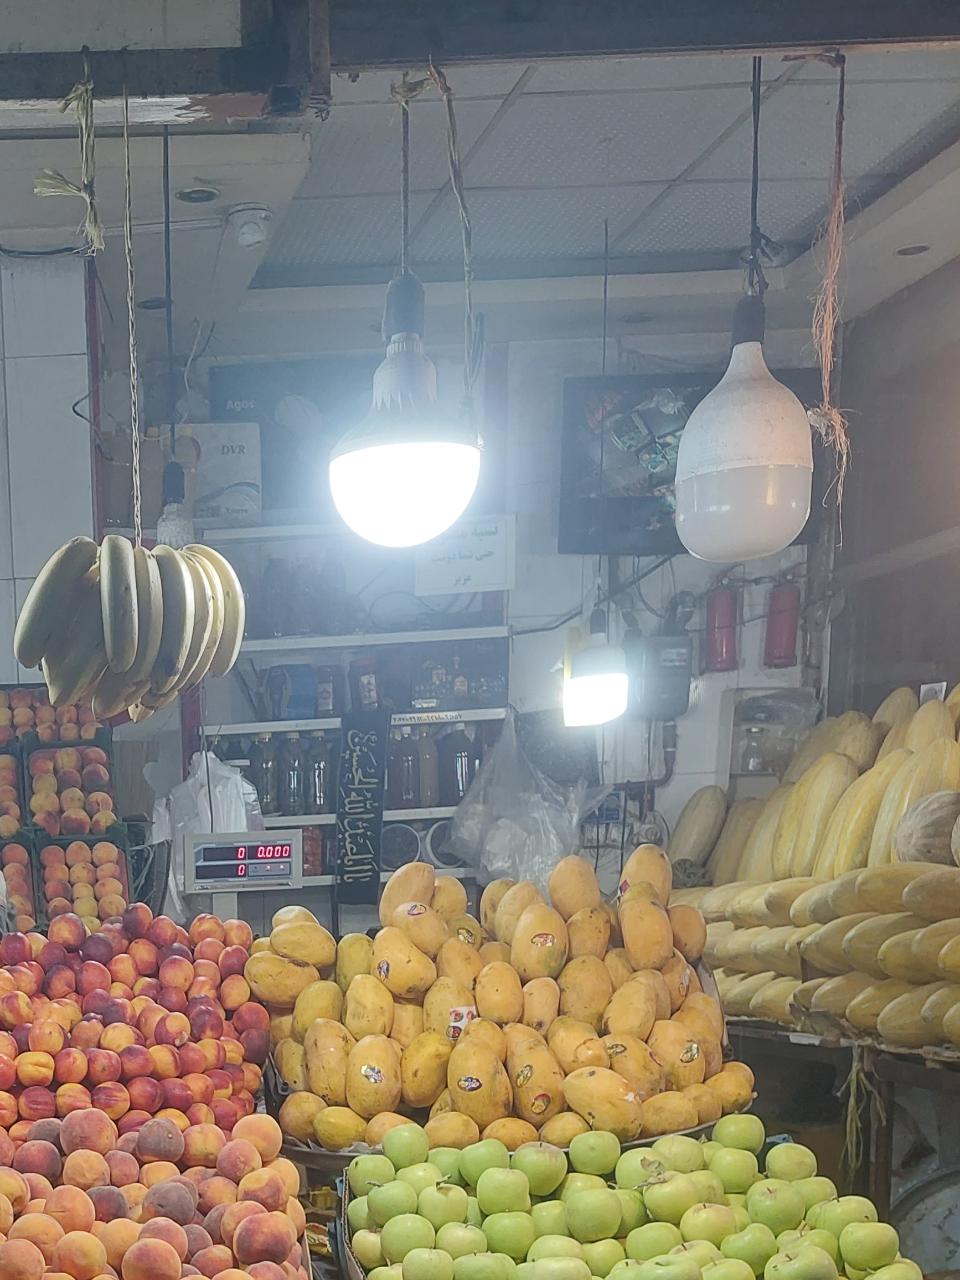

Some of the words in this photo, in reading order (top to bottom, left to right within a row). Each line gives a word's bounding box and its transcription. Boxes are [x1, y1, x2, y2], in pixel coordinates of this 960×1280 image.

[221, 444, 246, 456] DVR
[237, 847, 246, 859] 0
[257, 845, 290, 858] 0.000
[237, 864, 246, 876] 0
